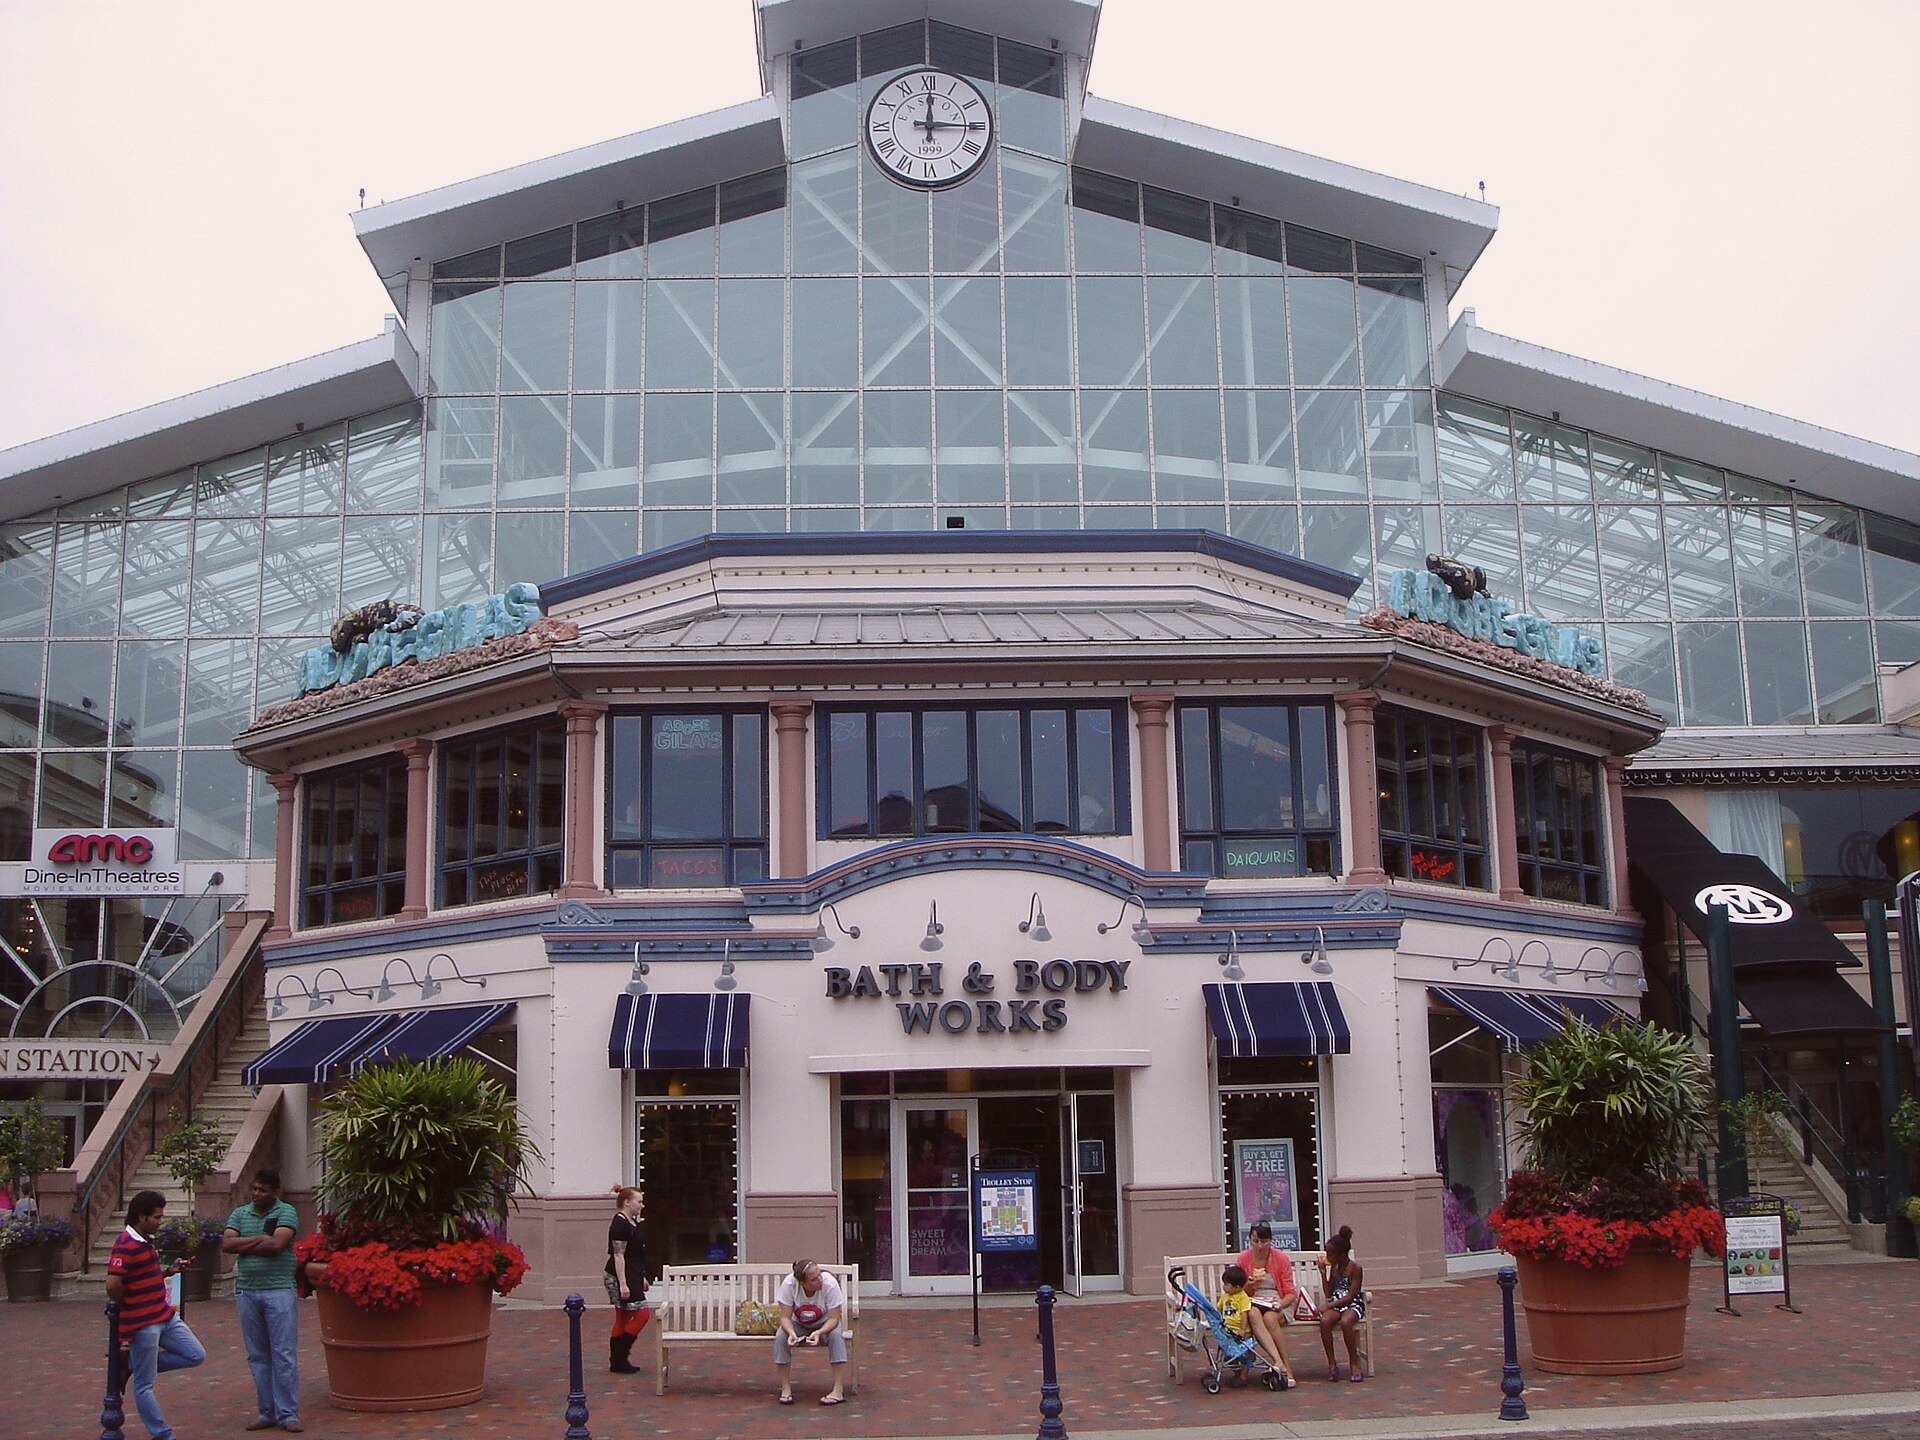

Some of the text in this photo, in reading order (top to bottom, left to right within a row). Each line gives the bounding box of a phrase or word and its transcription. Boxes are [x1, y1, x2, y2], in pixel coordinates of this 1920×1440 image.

[896, 81, 913, 97] XI
[879, 98, 896, 111] X
[898, 97, 961, 122] EASTON
[963, 98, 978, 110] II
[918, 146, 943, 155] 1999
[924, 162, 937, 178] VI
[950, 158, 962, 173] V
[663, 719, 710, 735] ADOBE
[654, 731, 721, 750] GILA'S
[1681, 770, 1725, 778] VINTAGE
[1807, 768, 1827, 776] BAR
[1226, 849, 1296, 867] DAIQUIRIS
[657, 858, 719, 876] TACOS
[824, 959, 1131, 998] BATH & BODY
[896, 998, 1068, 1034] WORKS
[17, 1049, 143, 1072] STATION
[1243, 1151, 1258, 1160] BUY
[1270, 1150, 1284, 1159] GET
[1244, 1160, 1285, 1172] 2 FREE
[911, 1229, 945, 1238] SWEET
[911, 1238, 945, 1247] PEONY
[1271, 1239, 1296, 1249] SOAPS
[911, 1247, 946, 1256] DREAM
[112, 1258, 123, 1267] 73
